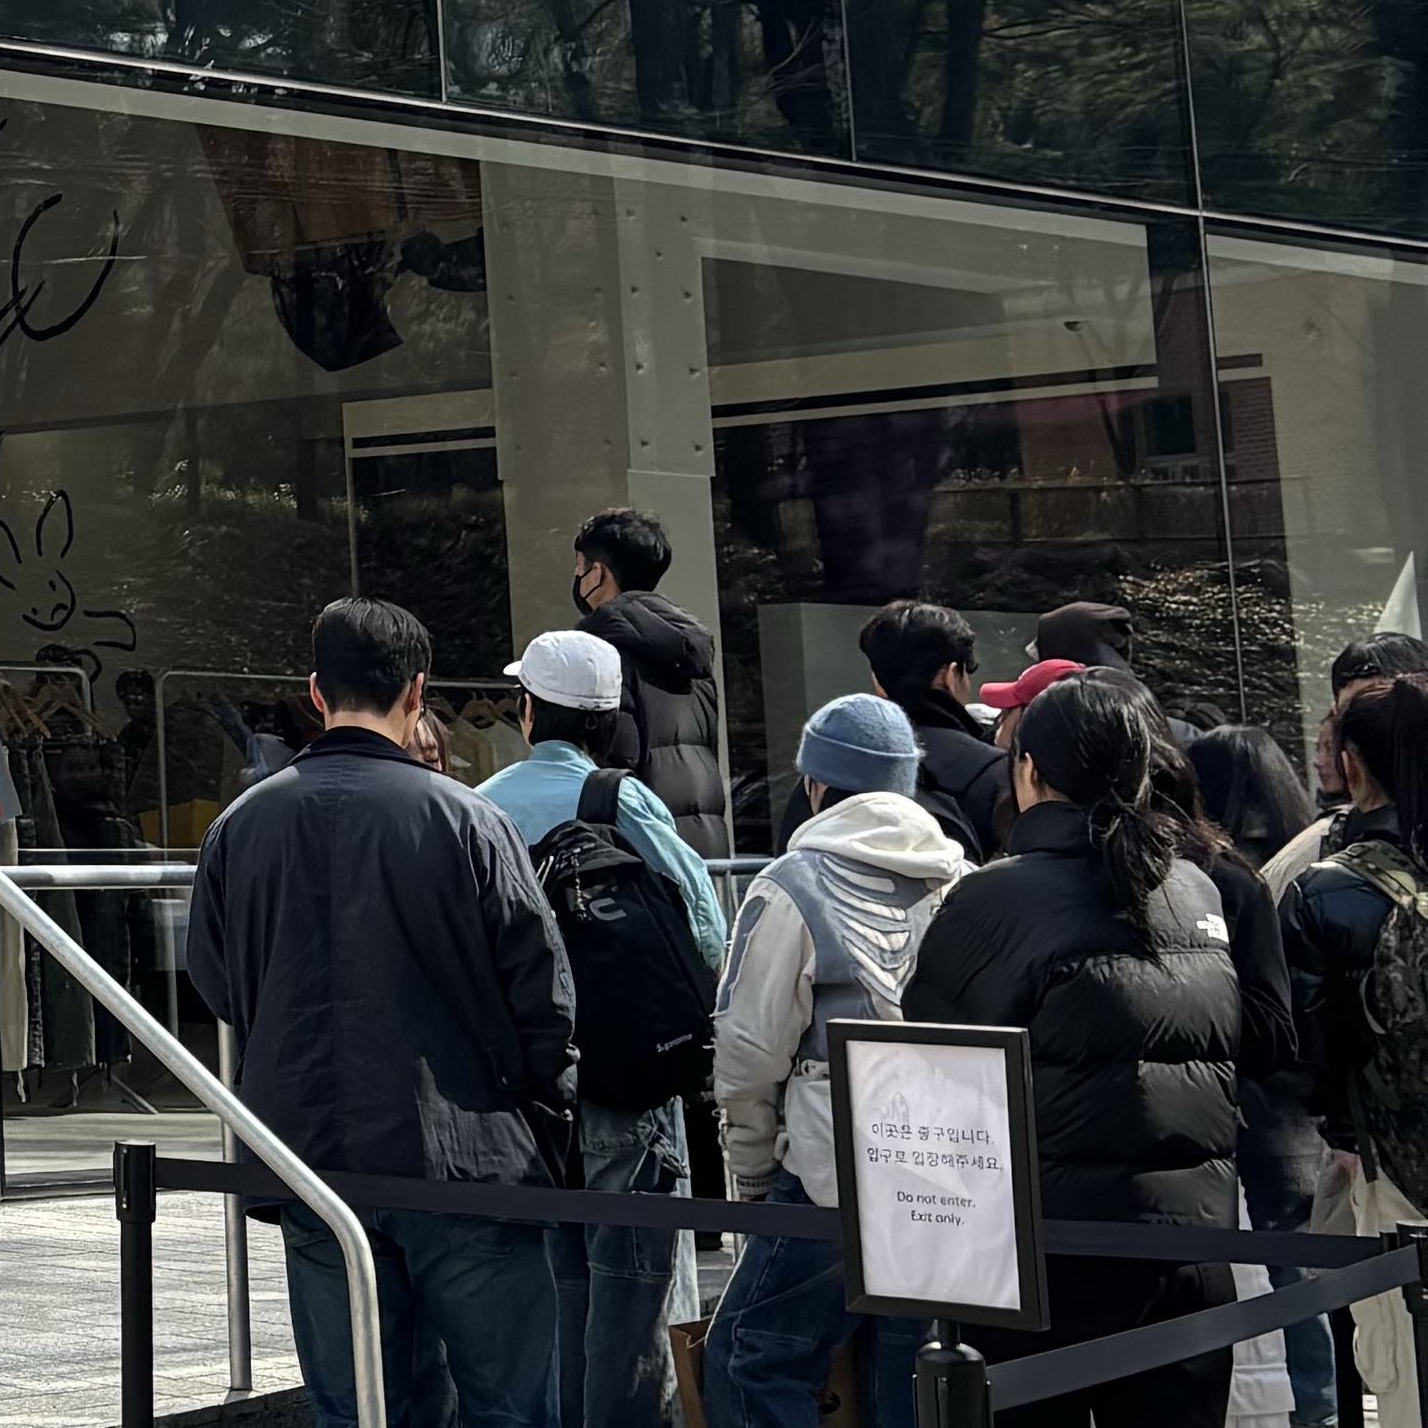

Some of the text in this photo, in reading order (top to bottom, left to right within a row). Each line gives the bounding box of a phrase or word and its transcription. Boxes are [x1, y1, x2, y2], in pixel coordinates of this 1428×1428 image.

[871, 1122, 913, 1140] 이곳은
[897, 1191, 976, 1209] Do not enter.
[911, 1209, 964, 1226] Exit only.
